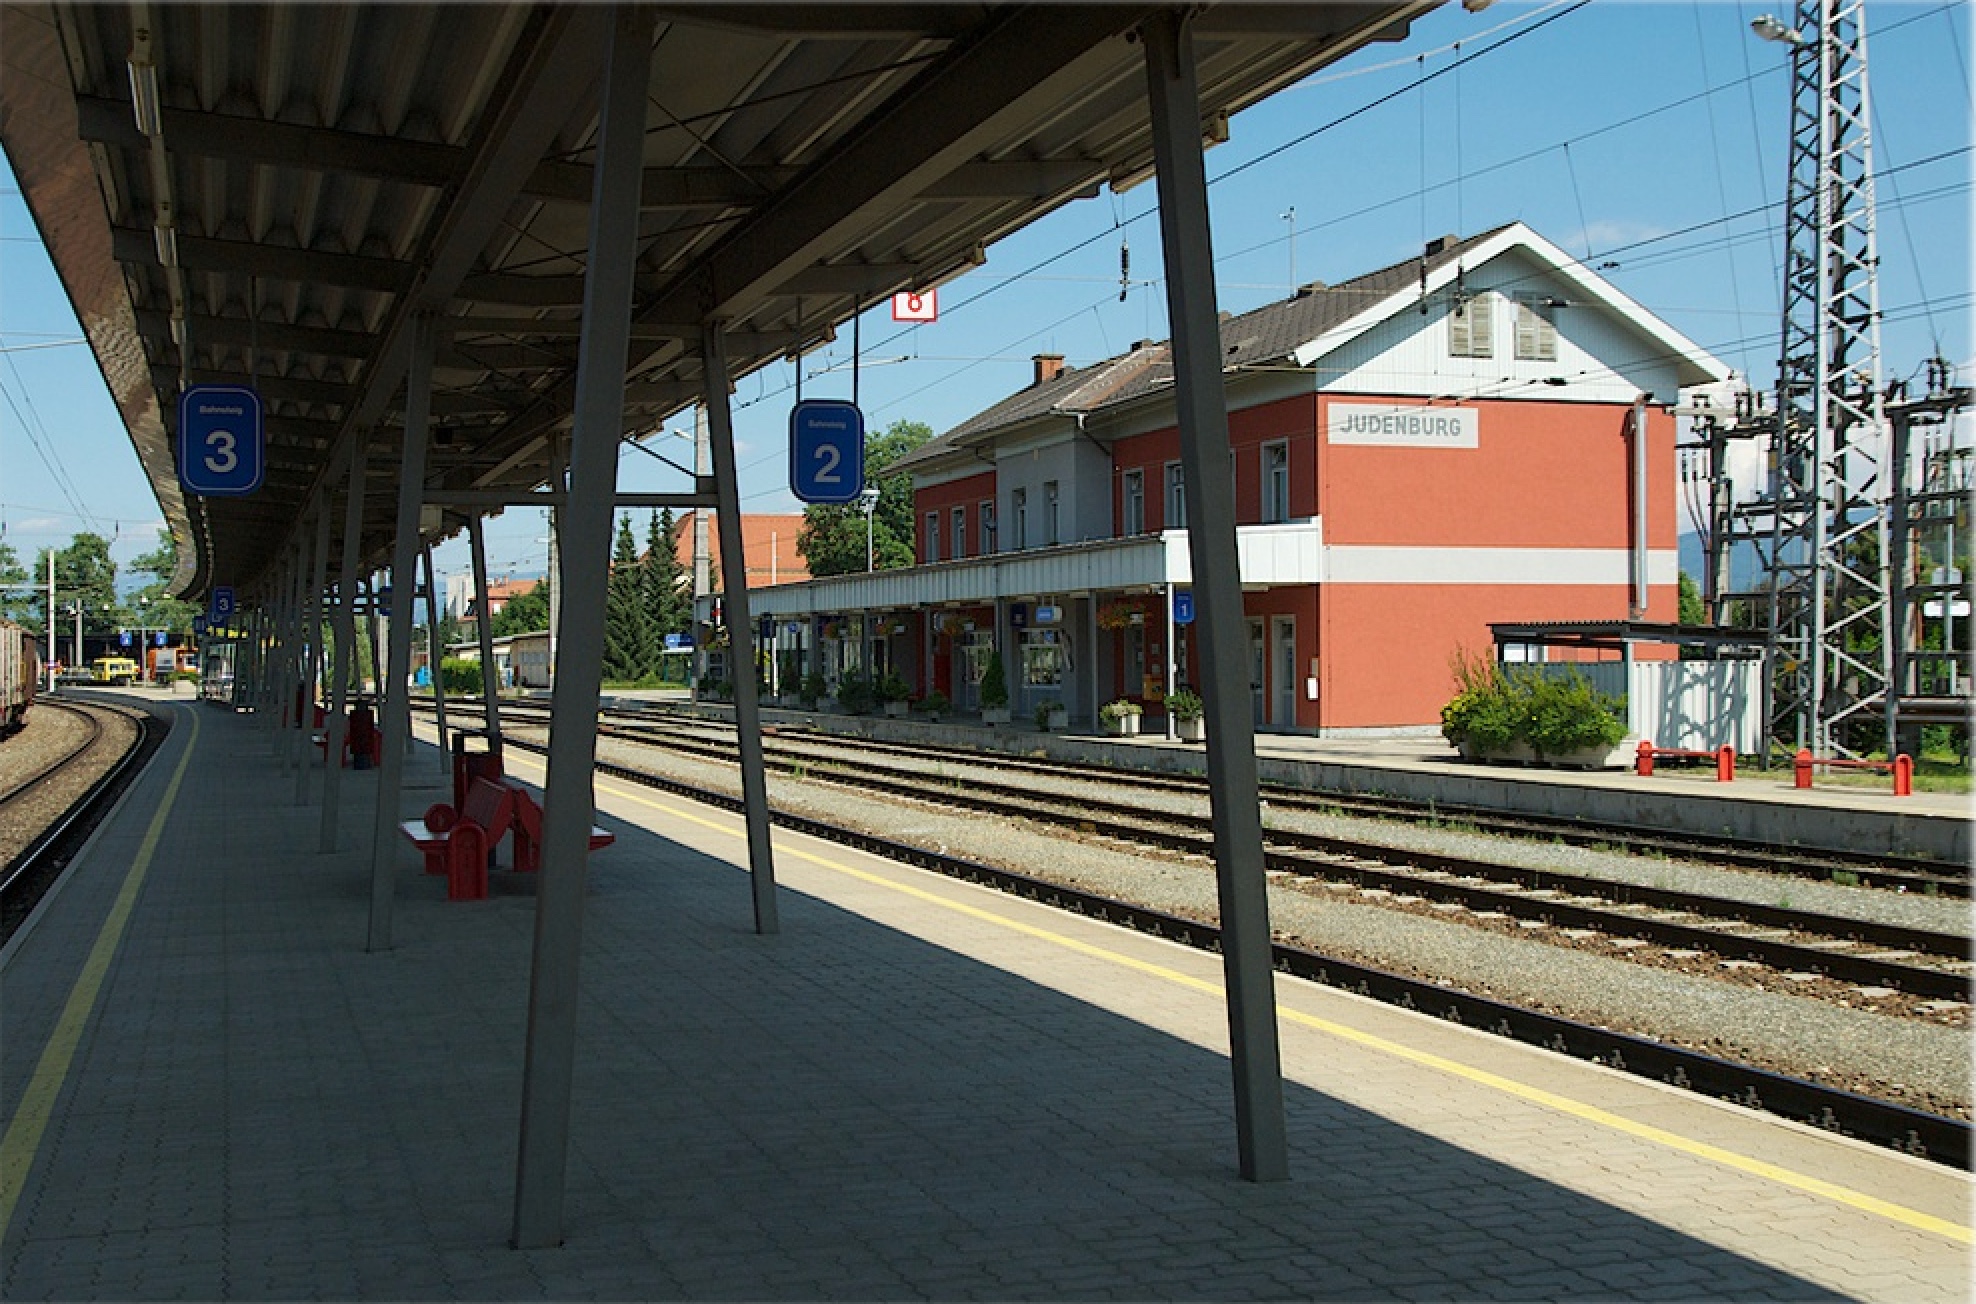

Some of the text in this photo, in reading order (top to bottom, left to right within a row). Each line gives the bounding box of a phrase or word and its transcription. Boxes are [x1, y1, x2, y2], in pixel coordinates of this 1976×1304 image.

[1340, 413, 1461, 436] JUDENBURG
[204, 430, 238, 473] 3
[814, 444, 841, 483] 2
[219, 597, 229, 612] 3
[1181, 603, 1187, 617] 1
